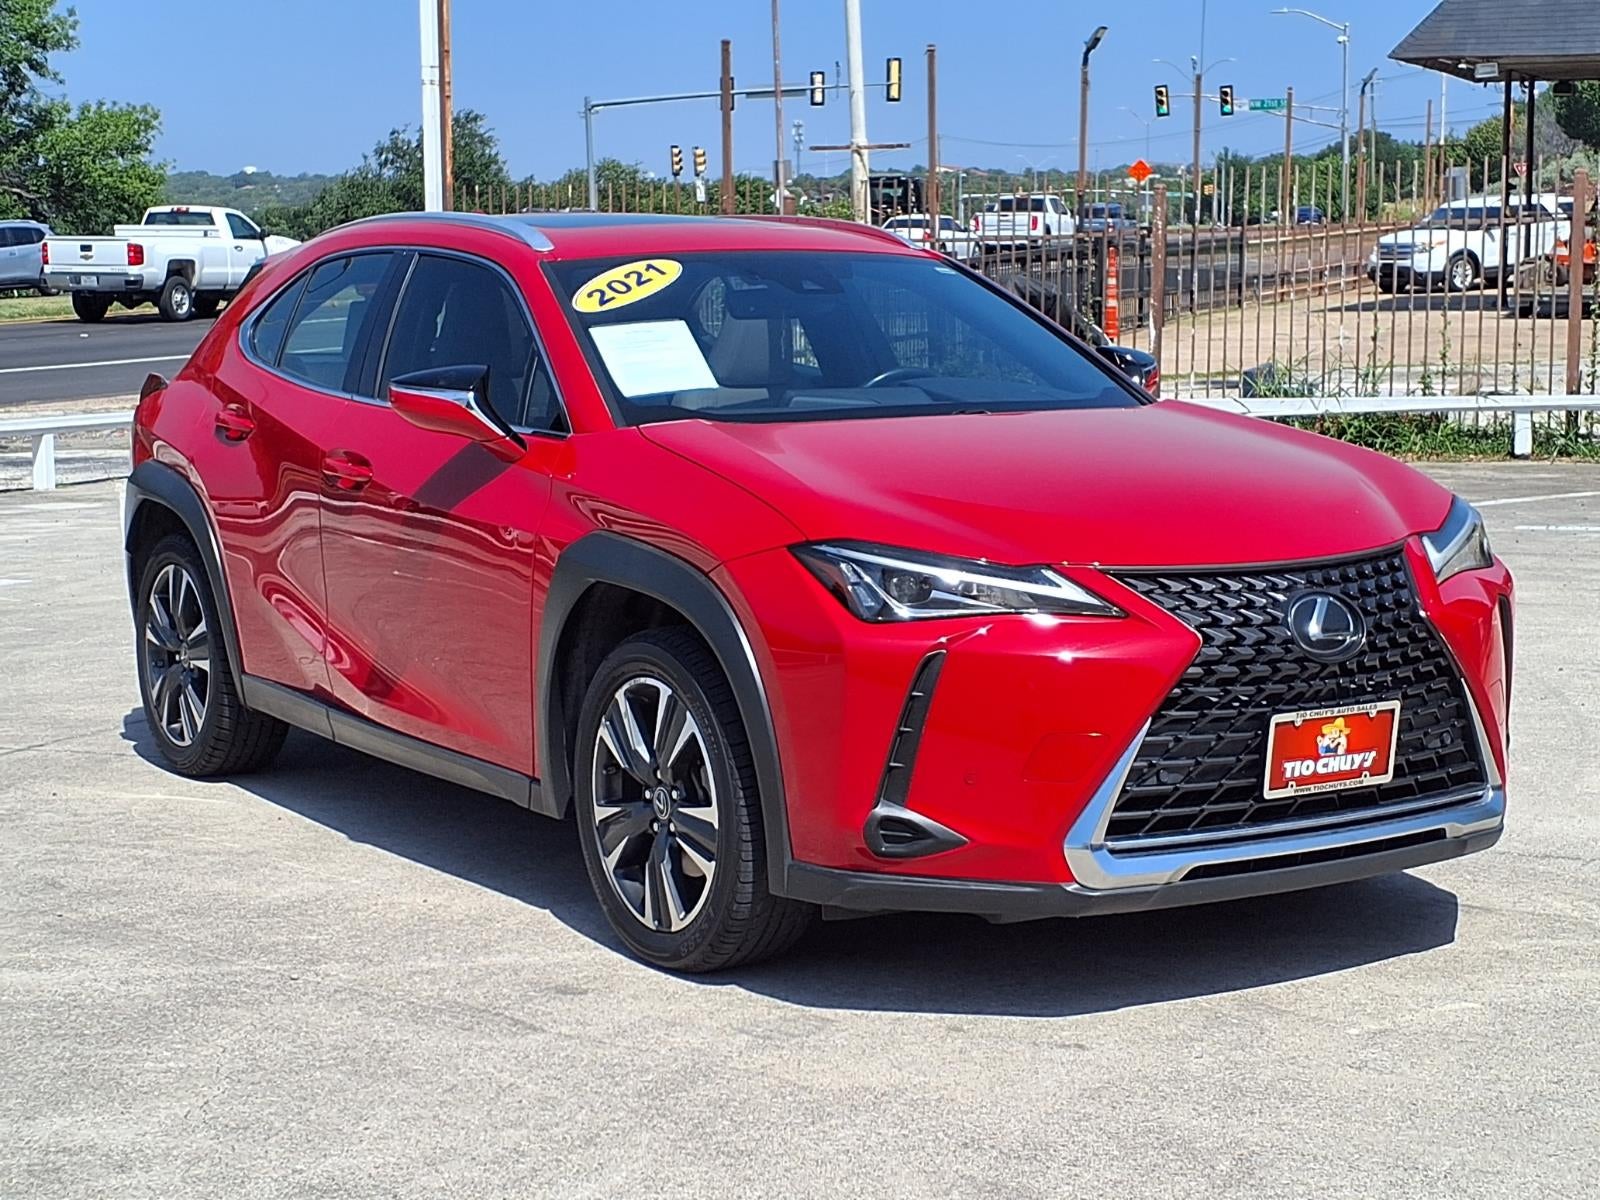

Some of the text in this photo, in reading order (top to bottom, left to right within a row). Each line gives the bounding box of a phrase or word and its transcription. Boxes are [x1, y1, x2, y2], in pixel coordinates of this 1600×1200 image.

[587, 263, 667, 307] 2021
[1296, 703, 1378, 719] TIO CHUY'S AUTO SALES
[1283, 750, 1377, 779] TIO CHUY'S
